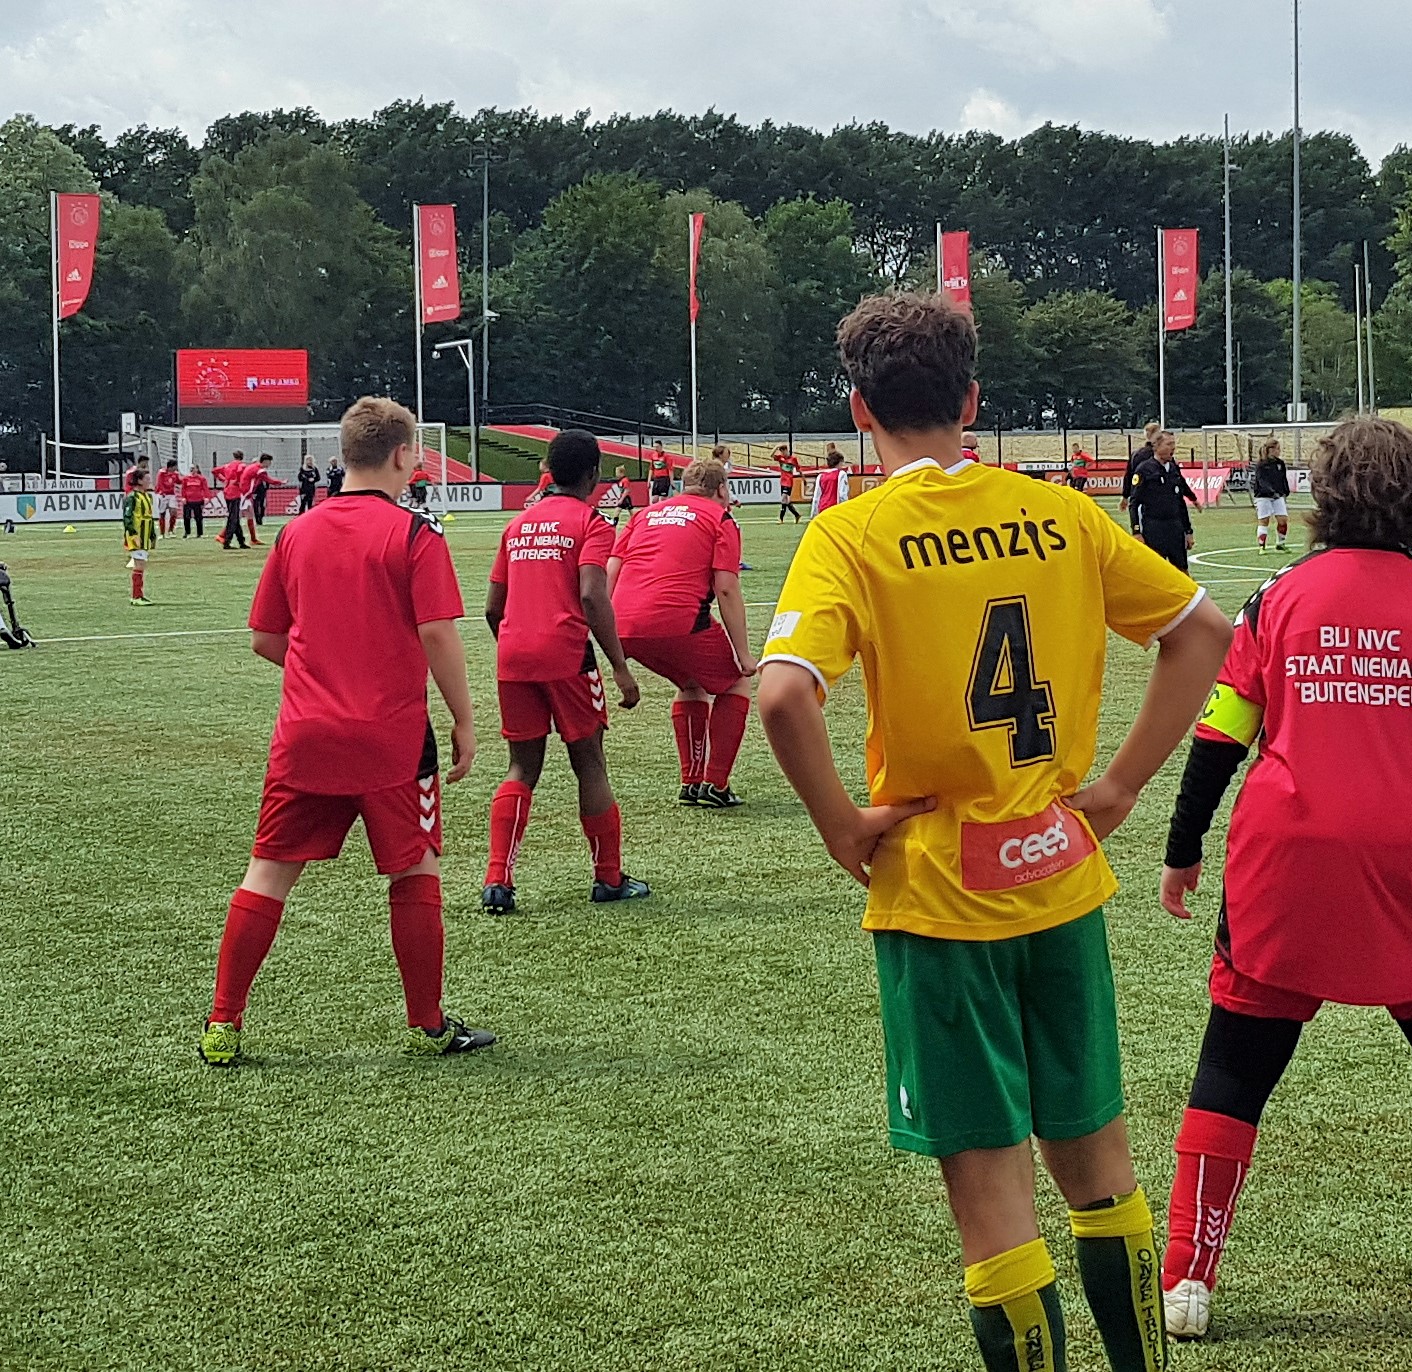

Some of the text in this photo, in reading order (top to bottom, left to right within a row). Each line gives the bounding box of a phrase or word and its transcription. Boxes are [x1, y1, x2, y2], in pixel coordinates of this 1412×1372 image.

[728, 479, 773, 495] AMRO
[44, 493, 125, 511] ABN·AM
[539, 521, 560, 533] NVC
[507, 535, 574, 551] STAAT NIEMAND
[898, 508, 1067, 570] menzis
[1357, 628, 1401, 652] NVC
[1285, 655, 1345, 677] STAAT
[965, 594, 1056, 769] 4
